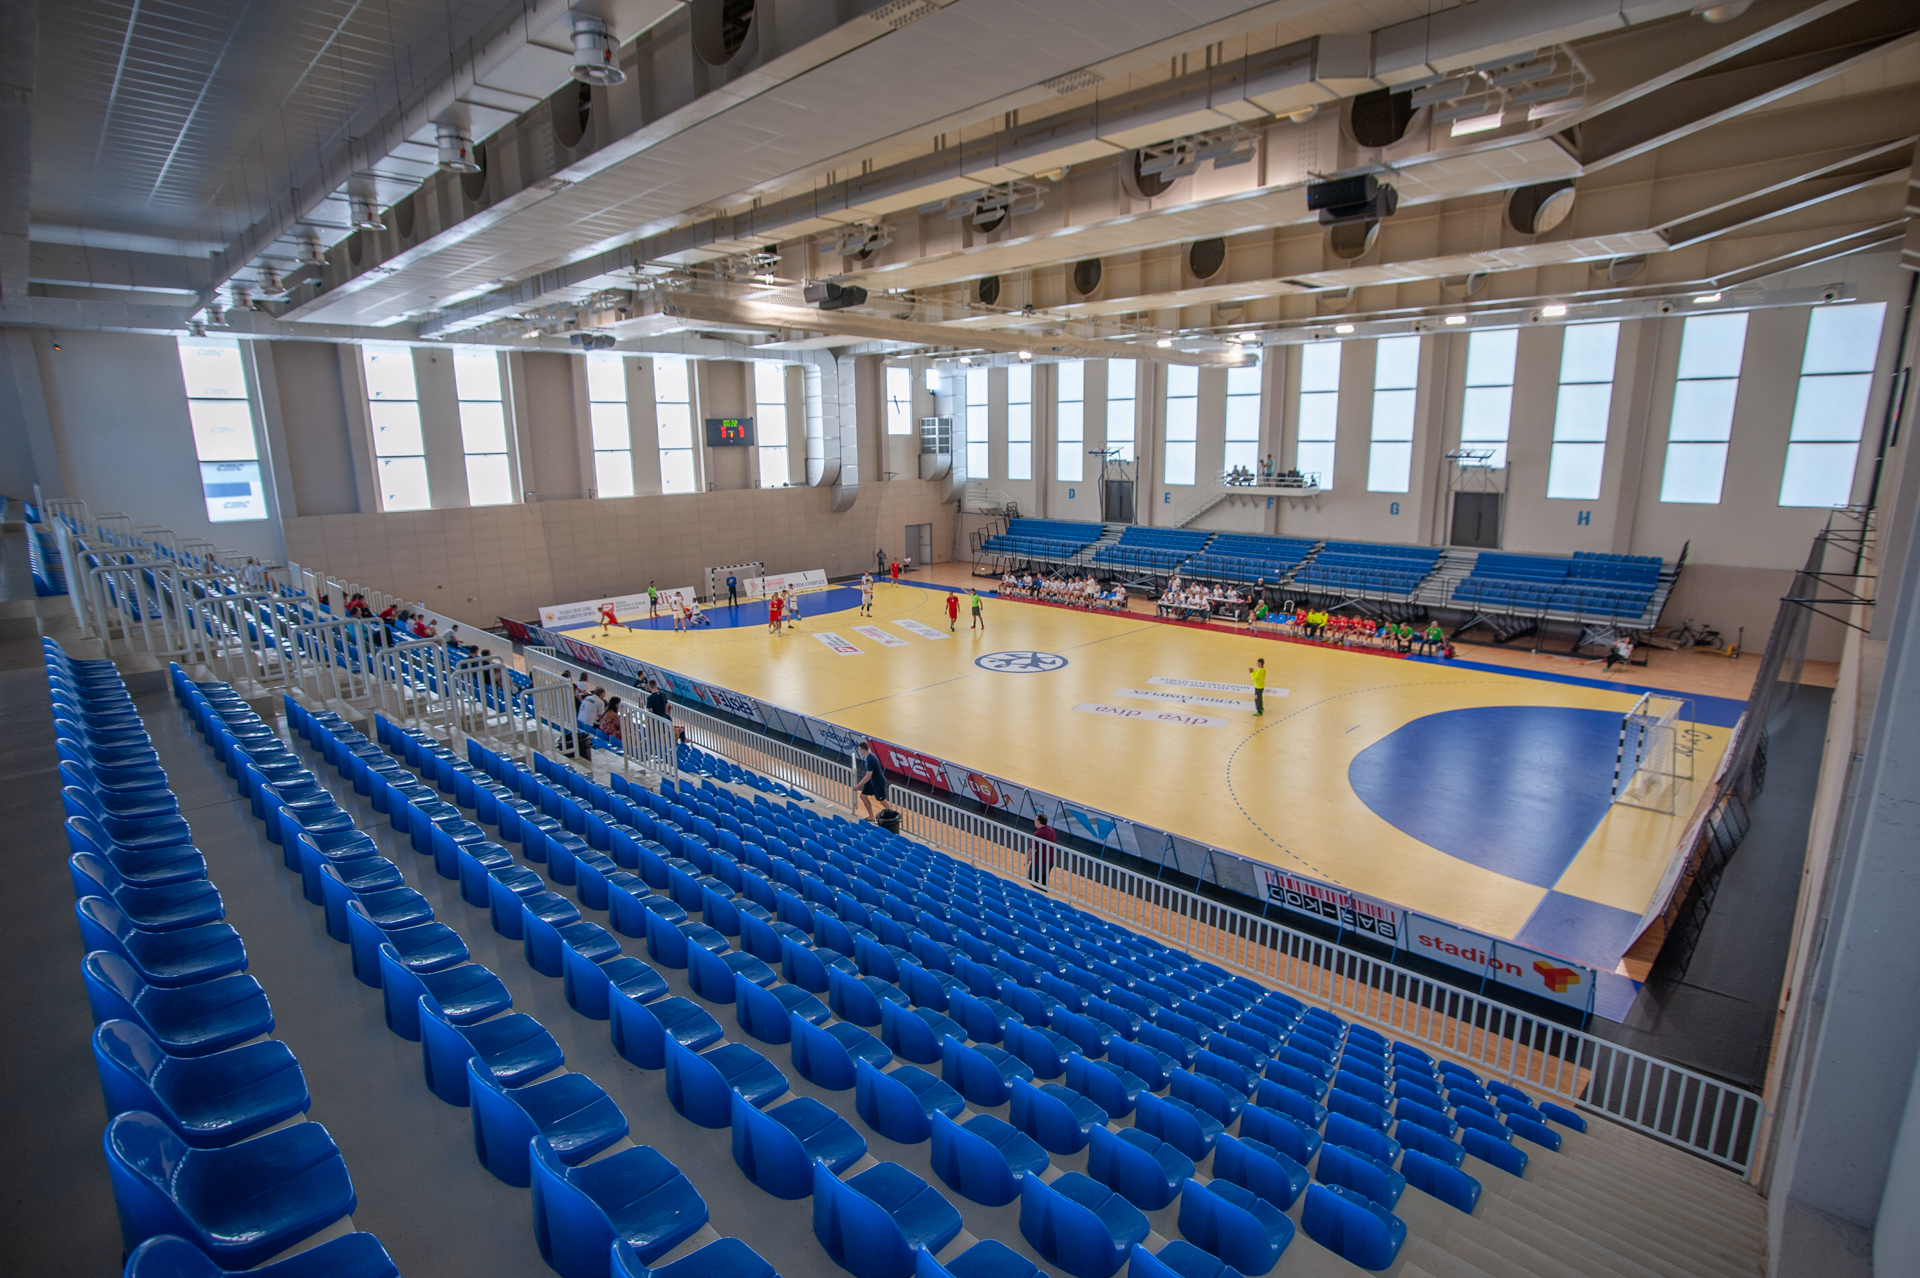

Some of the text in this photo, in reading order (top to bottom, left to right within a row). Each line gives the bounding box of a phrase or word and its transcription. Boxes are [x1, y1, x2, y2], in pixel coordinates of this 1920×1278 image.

[1069, 488, 1075, 499] D
[1164, 492, 1171, 504] E
[1267, 497, 1274, 509] F
[1390, 502, 1399, 515] G
[1578, 511, 1591, 526] H
[717, 692, 755, 716] ERSTE
[1132, 690, 1240, 705] VERDE COMPLEX
[1095, 706, 1208, 725] diva diva
[957, 776, 991, 796] UDG
[1419, 934, 1523, 978] stadion
